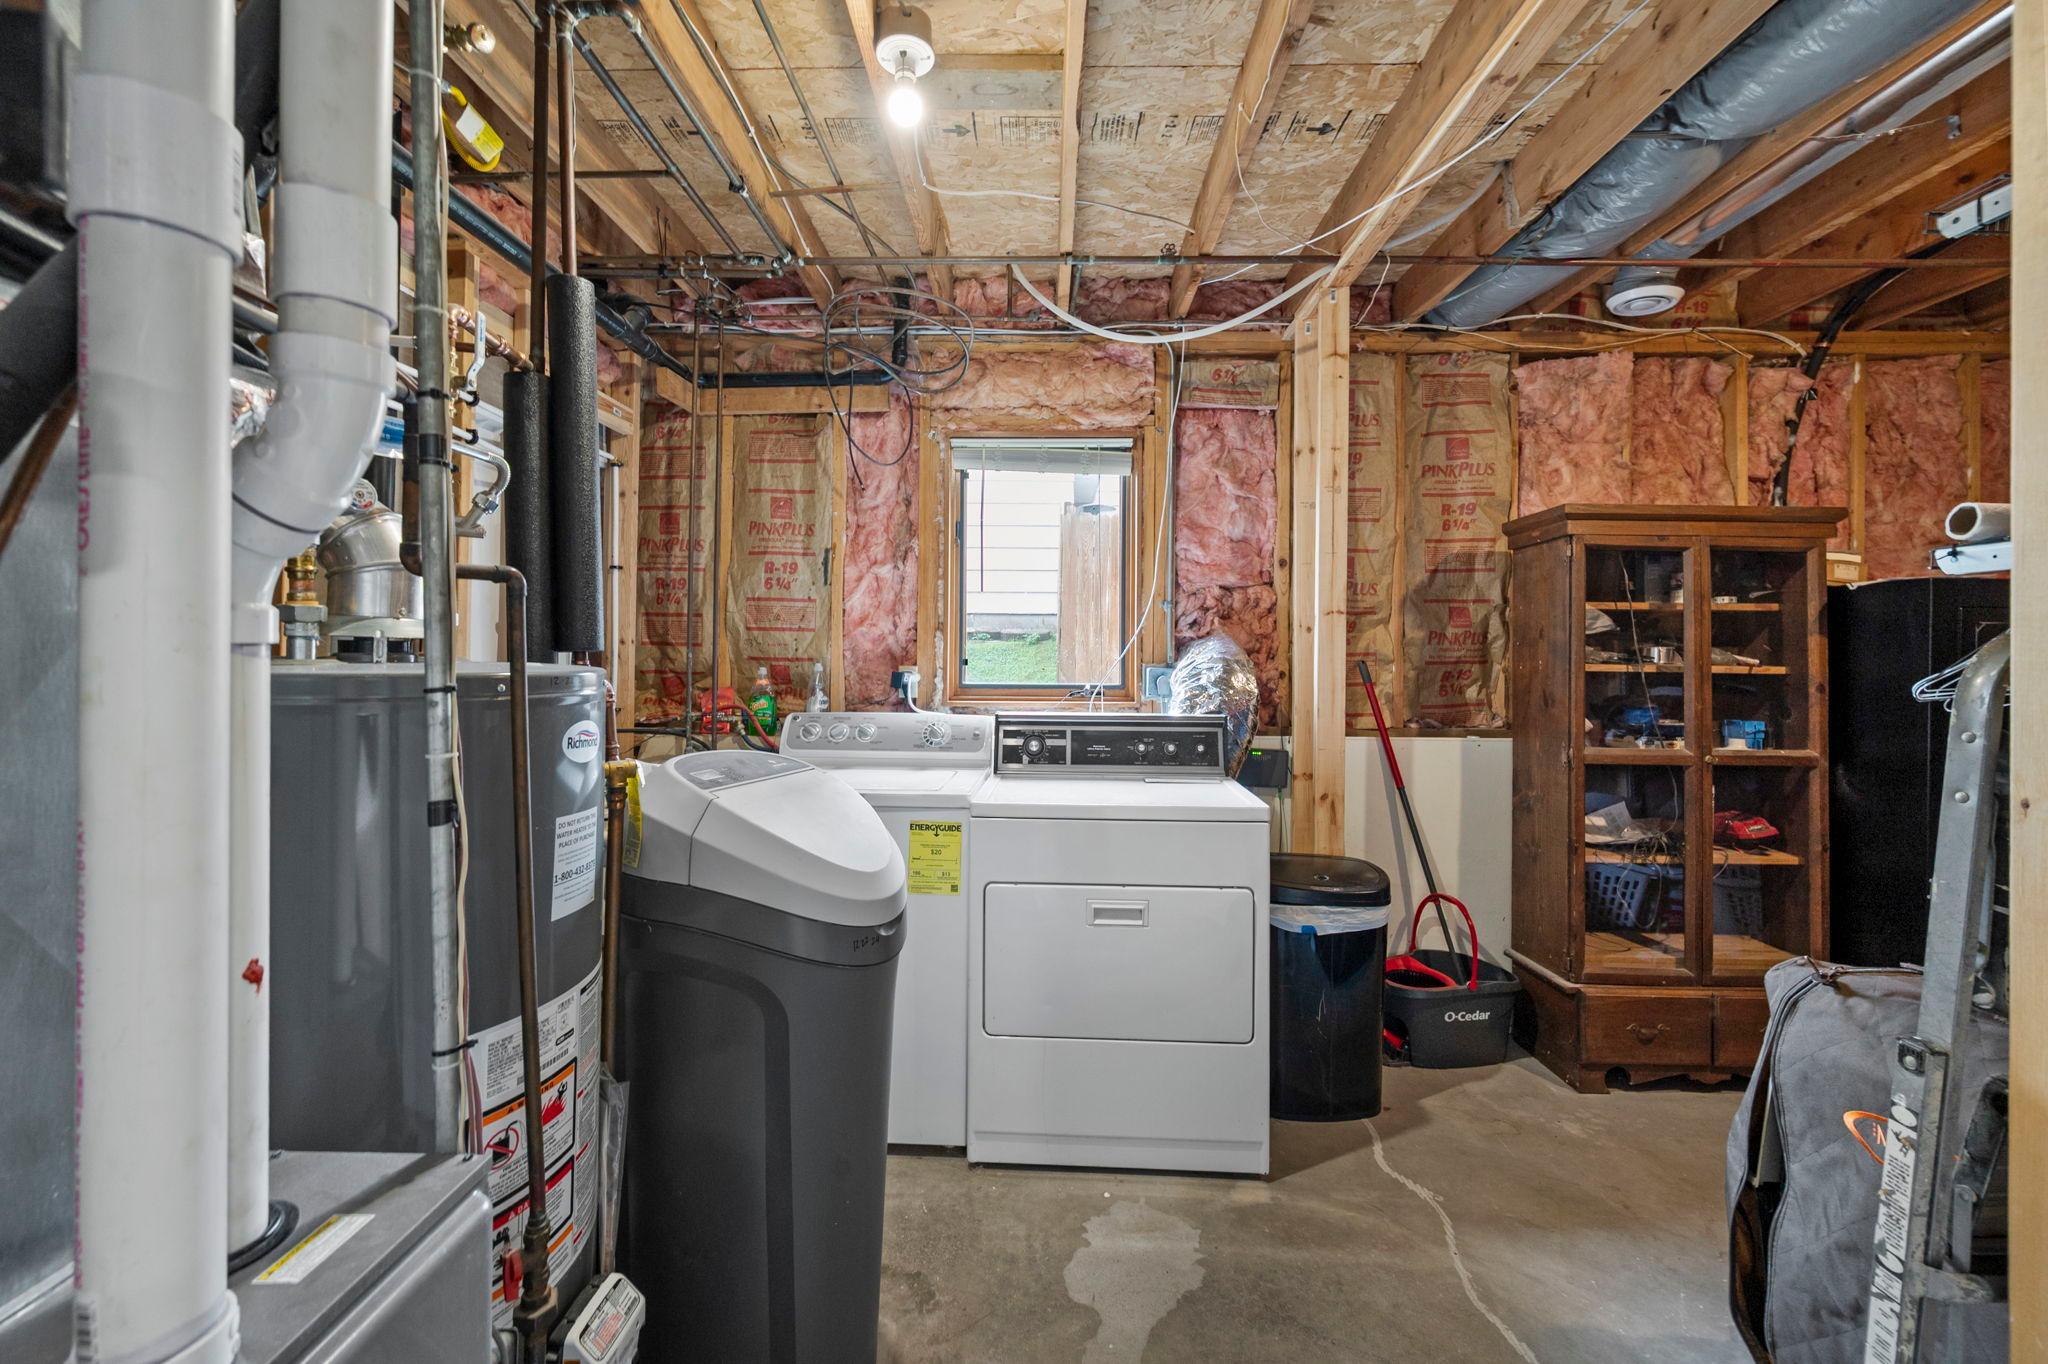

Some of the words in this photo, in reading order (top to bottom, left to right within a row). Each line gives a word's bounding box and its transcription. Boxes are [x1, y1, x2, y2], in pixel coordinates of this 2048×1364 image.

[1421, 462, 1496, 478] PINKPLUS
[1441, 502, 1477, 516] R-19
[748, 520, 815, 538] PINKPLUS
[1442, 518, 1451, 531] 6
[764, 561, 799, 575] R-19
[655, 577, 687, 590] R-19
[764, 577, 773, 590] 6
[1428, 629, 1487, 646] PINKPLU
[567, 735, 598, 750] Richmond
[566, 819, 576, 828] NOT
[556, 829, 573, 839] WATER
[558, 839, 572, 849] PLACE
